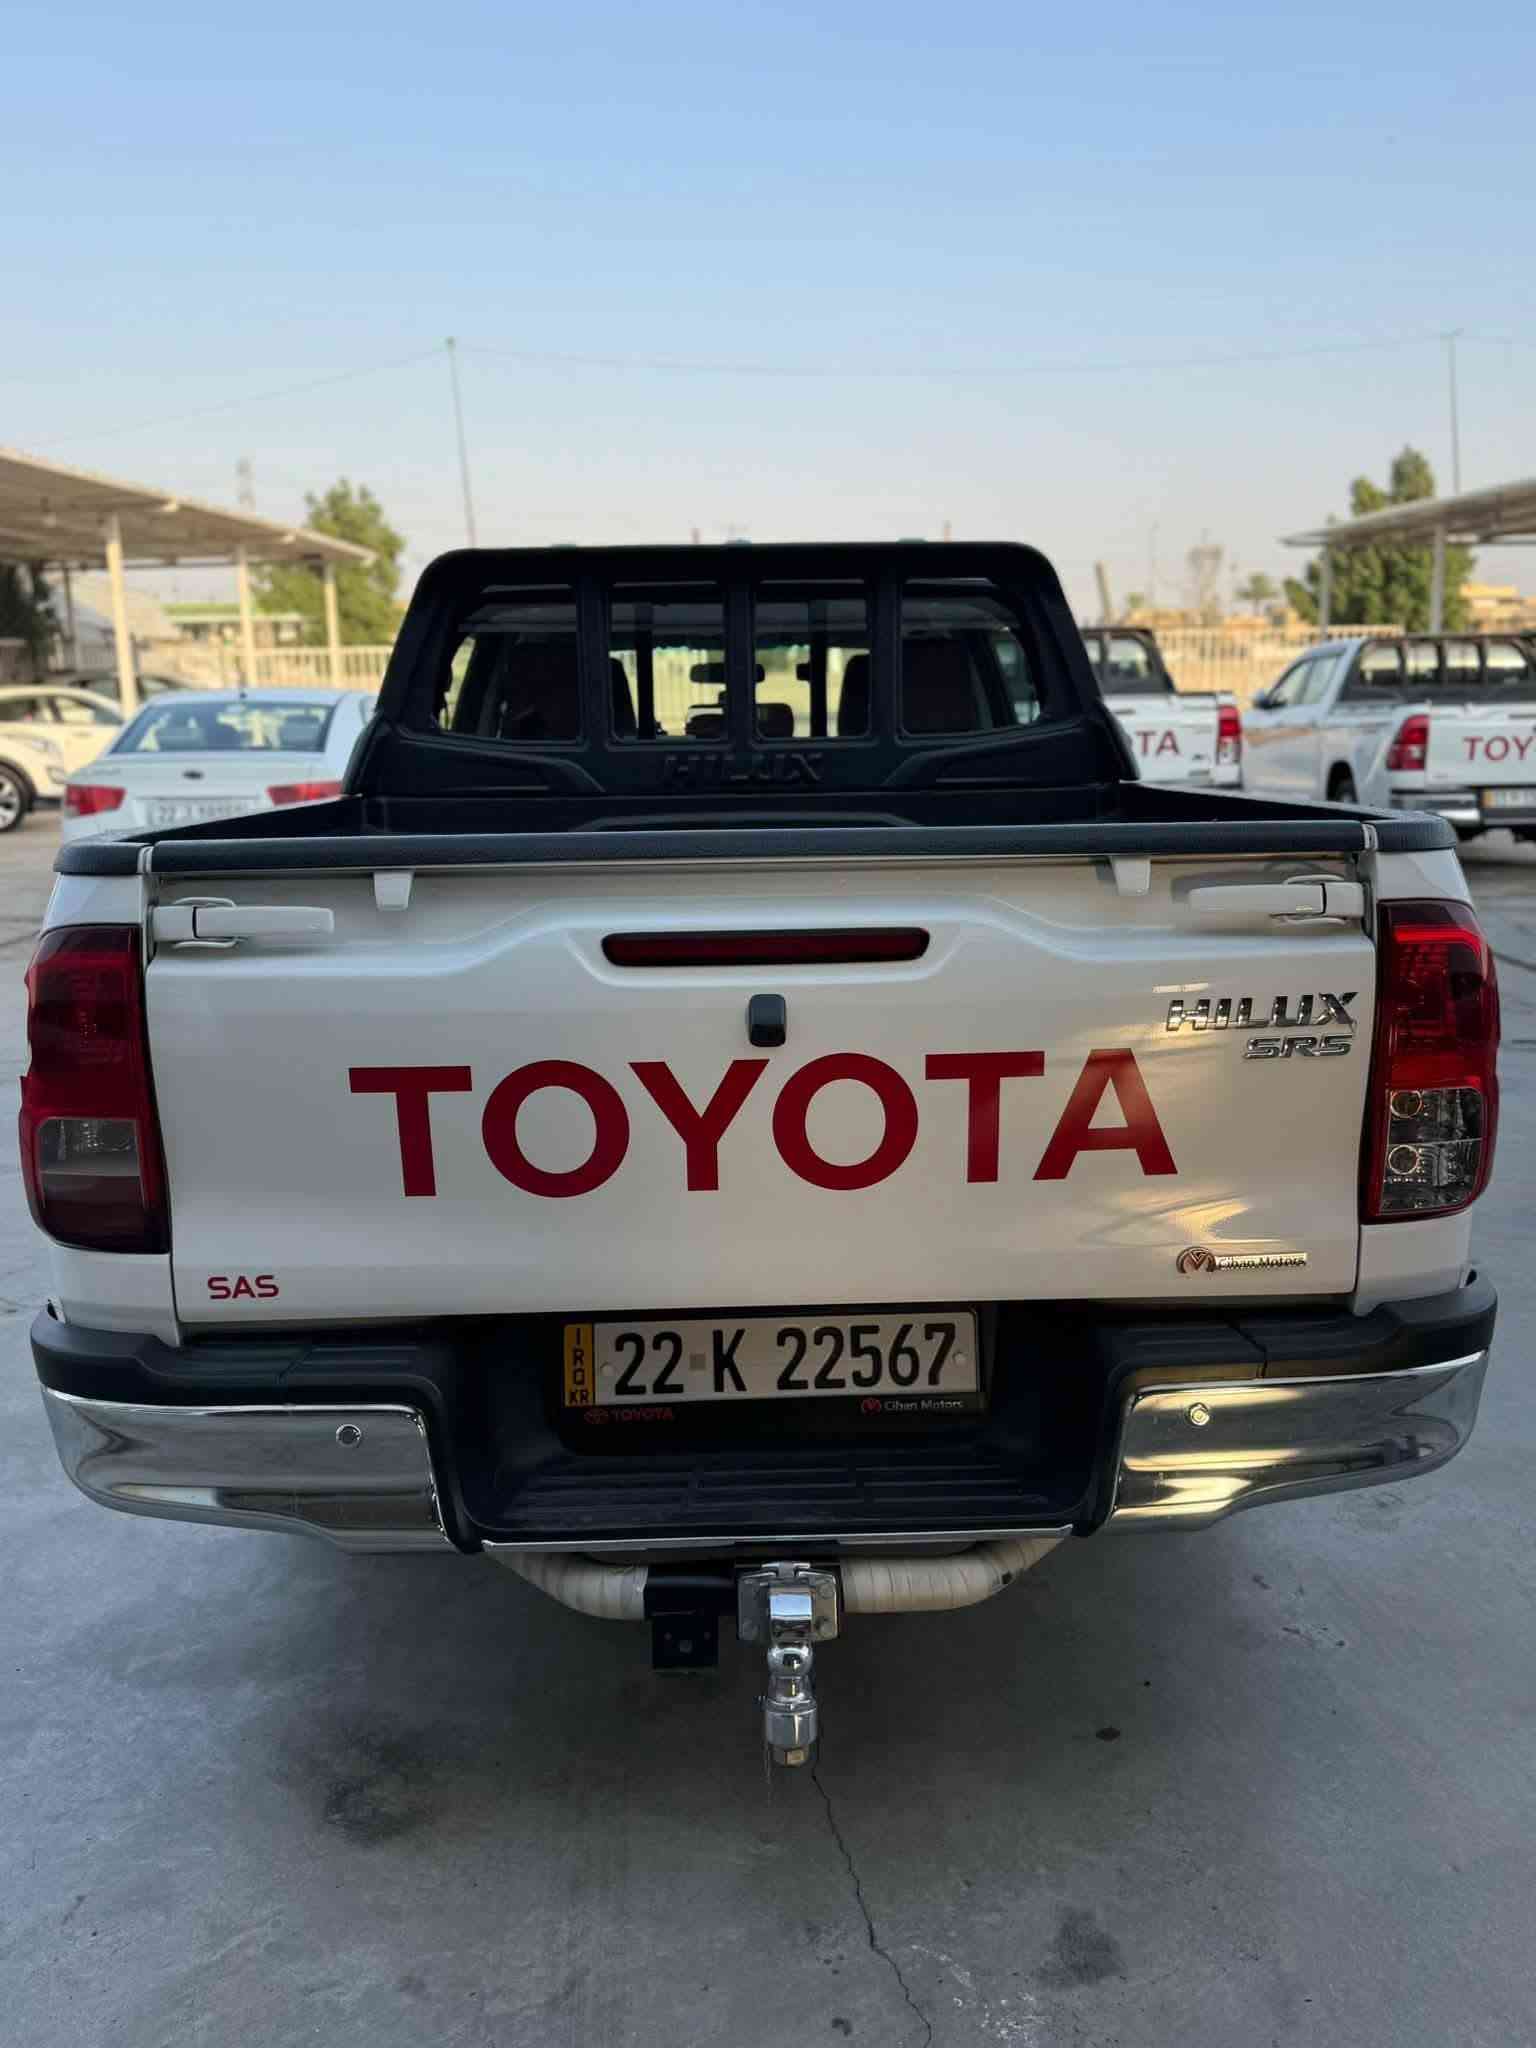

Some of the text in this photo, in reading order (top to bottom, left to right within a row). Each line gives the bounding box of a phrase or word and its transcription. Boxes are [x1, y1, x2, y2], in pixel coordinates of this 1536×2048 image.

[1166, 992, 1358, 1031] HILUX
[1243, 1035, 1353, 1059] SR5
[349, 1048, 1178, 1198] TOYOTA
[207, 1275, 279, 1300] SAS
[614, 1323, 956, 1395] 22 K 22567
[612, 1407, 674, 1422] TOYOTA
[920, 1398, 965, 1410] Motors
